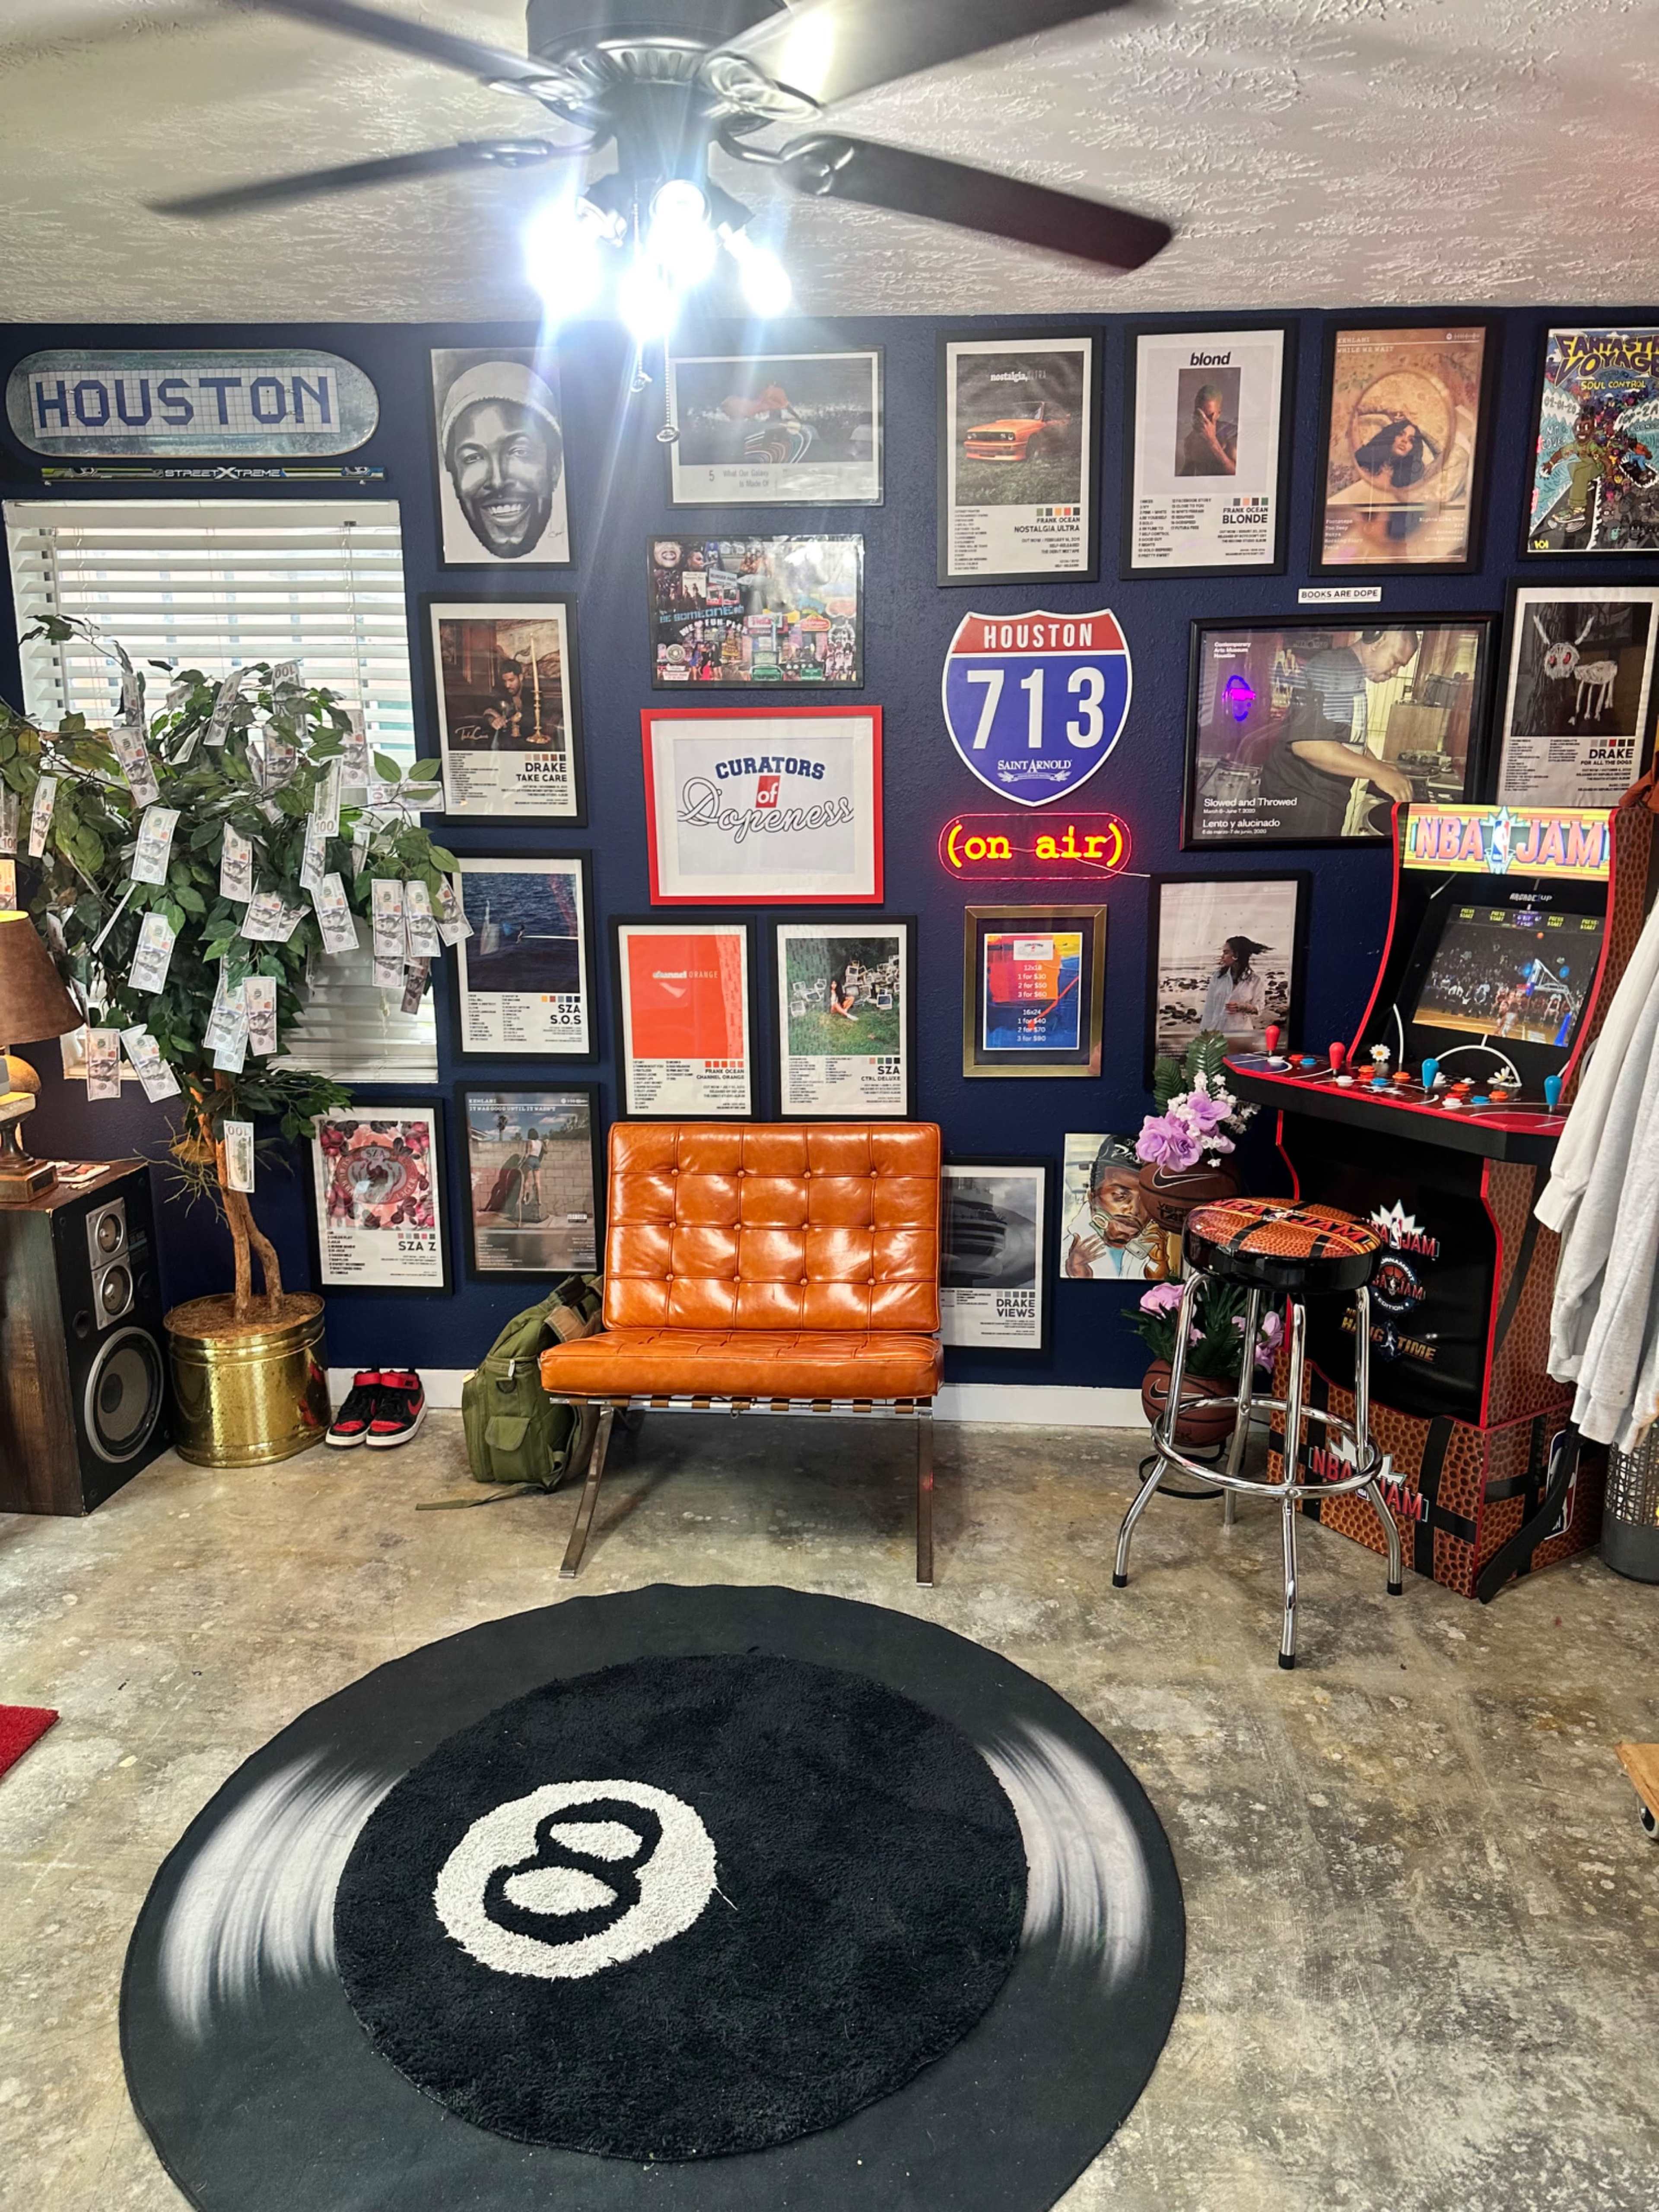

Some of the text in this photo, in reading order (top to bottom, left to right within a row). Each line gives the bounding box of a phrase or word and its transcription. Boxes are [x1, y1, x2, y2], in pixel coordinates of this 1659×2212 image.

[1190, 352, 1231, 366] blond
[1581, 381, 1605, 390] SOUL
[35, 376, 332, 428] HOUSTON
[709, 470, 715, 482] 5
[1223, 514, 1268, 524] BLONDE
[984, 623, 1093, 648] HOUSTON
[967, 667, 1105, 750] 713
[1589, 748, 1634, 759] DRAKE
[525, 762, 566, 772] DRAKE
[715, 756, 825, 780] CURATORS
[757, 782, 778, 804] of
[1204, 797, 1297, 807] Slowed and Throwed
[677, 777, 854, 844] Dopeness
[316, 820, 334, 832] 100
[1203, 819, 1281, 829] Lento y alucinado
[1415, 816, 1605, 868] NBA JAM
[558, 1004, 581, 1013] SZA
[550, 1015, 582, 1025] S.O.S
[877, 1066, 900, 1075] SZA
[1289, 1215, 1371, 1244] JAM
[398, 1241, 436, 1252] SZA Z
[1402, 1231, 1437, 1258] JAM
[996, 1299, 1036, 1308] DRAKE
[1378, 1297, 1404, 1311] EDITION
[997, 1308, 1036, 1318] VIEWS
[1397, 1335, 1436, 1362] TIME
[1313, 1446, 1352, 1481] NBA
[482, 1797, 664, 1947] 8
